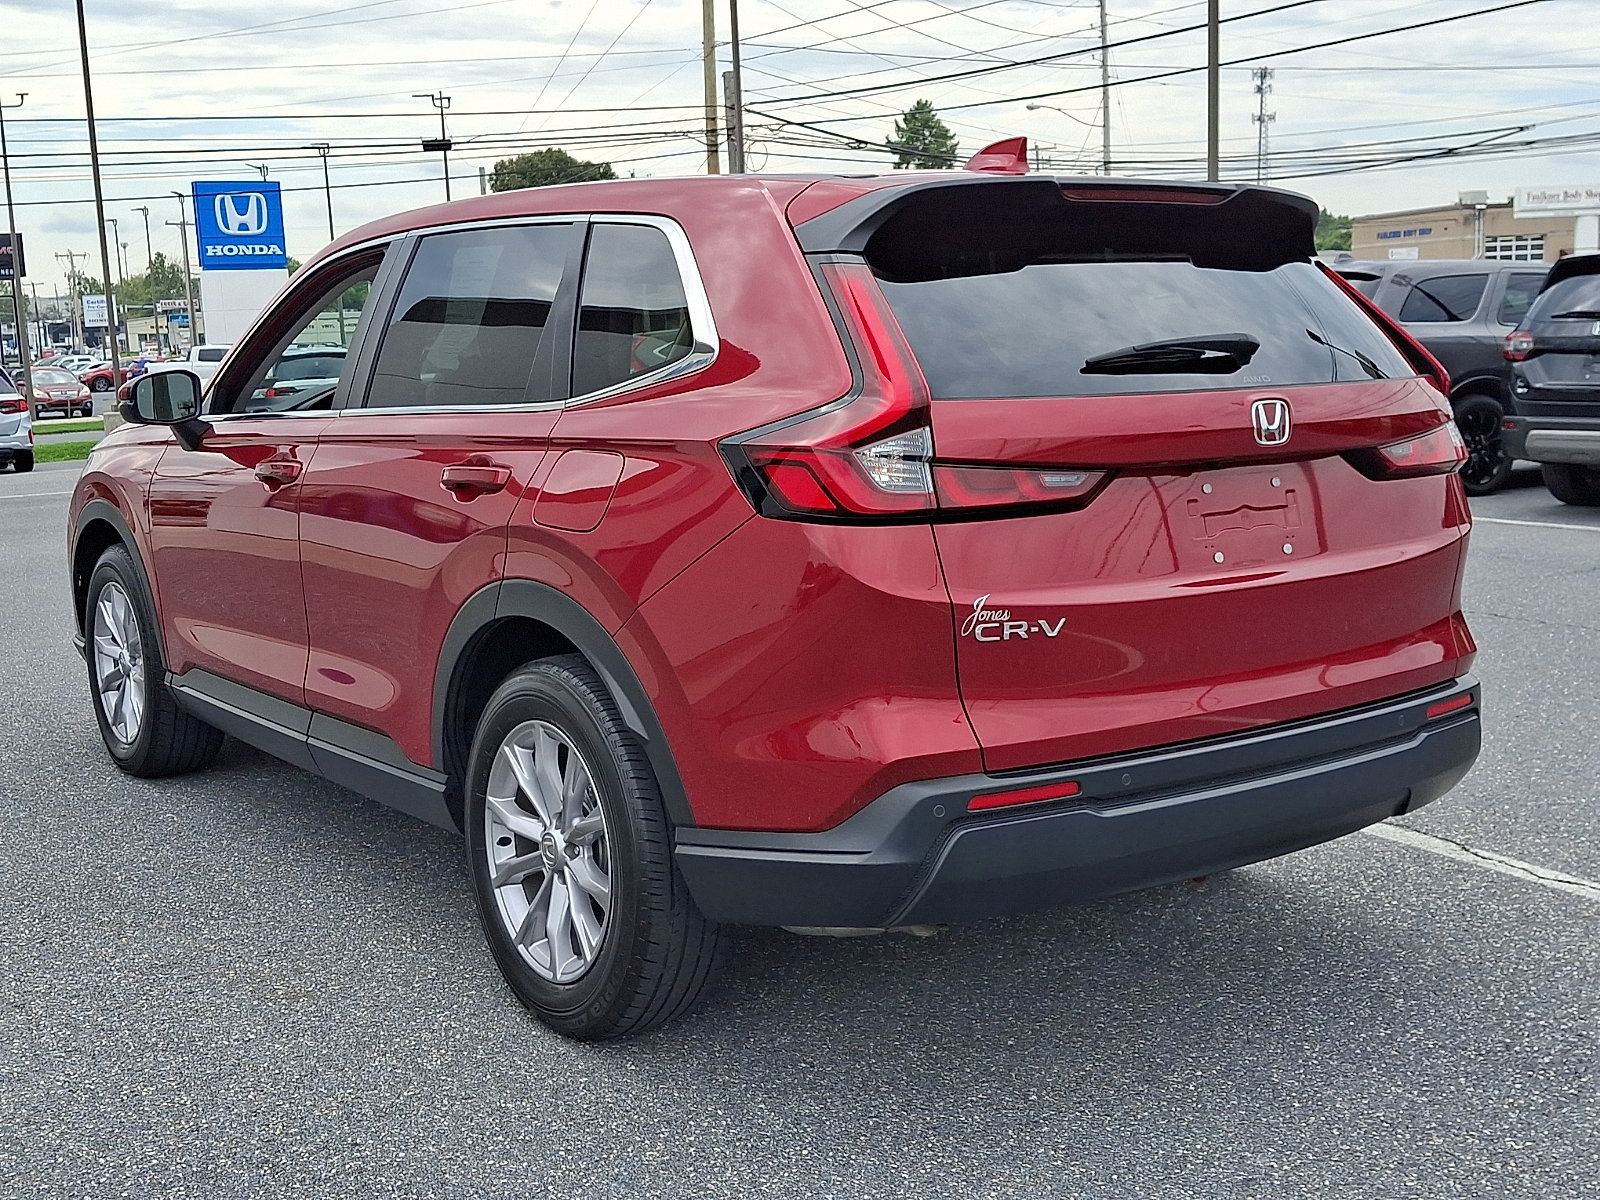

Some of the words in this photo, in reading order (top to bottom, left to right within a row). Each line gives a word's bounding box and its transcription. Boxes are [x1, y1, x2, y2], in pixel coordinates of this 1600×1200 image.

[205, 244, 283, 256] HONDA
[1243, 375, 1271, 383] AWD
[961, 593, 1011, 637] Jones
[974, 617, 1066, 642] CR-V
